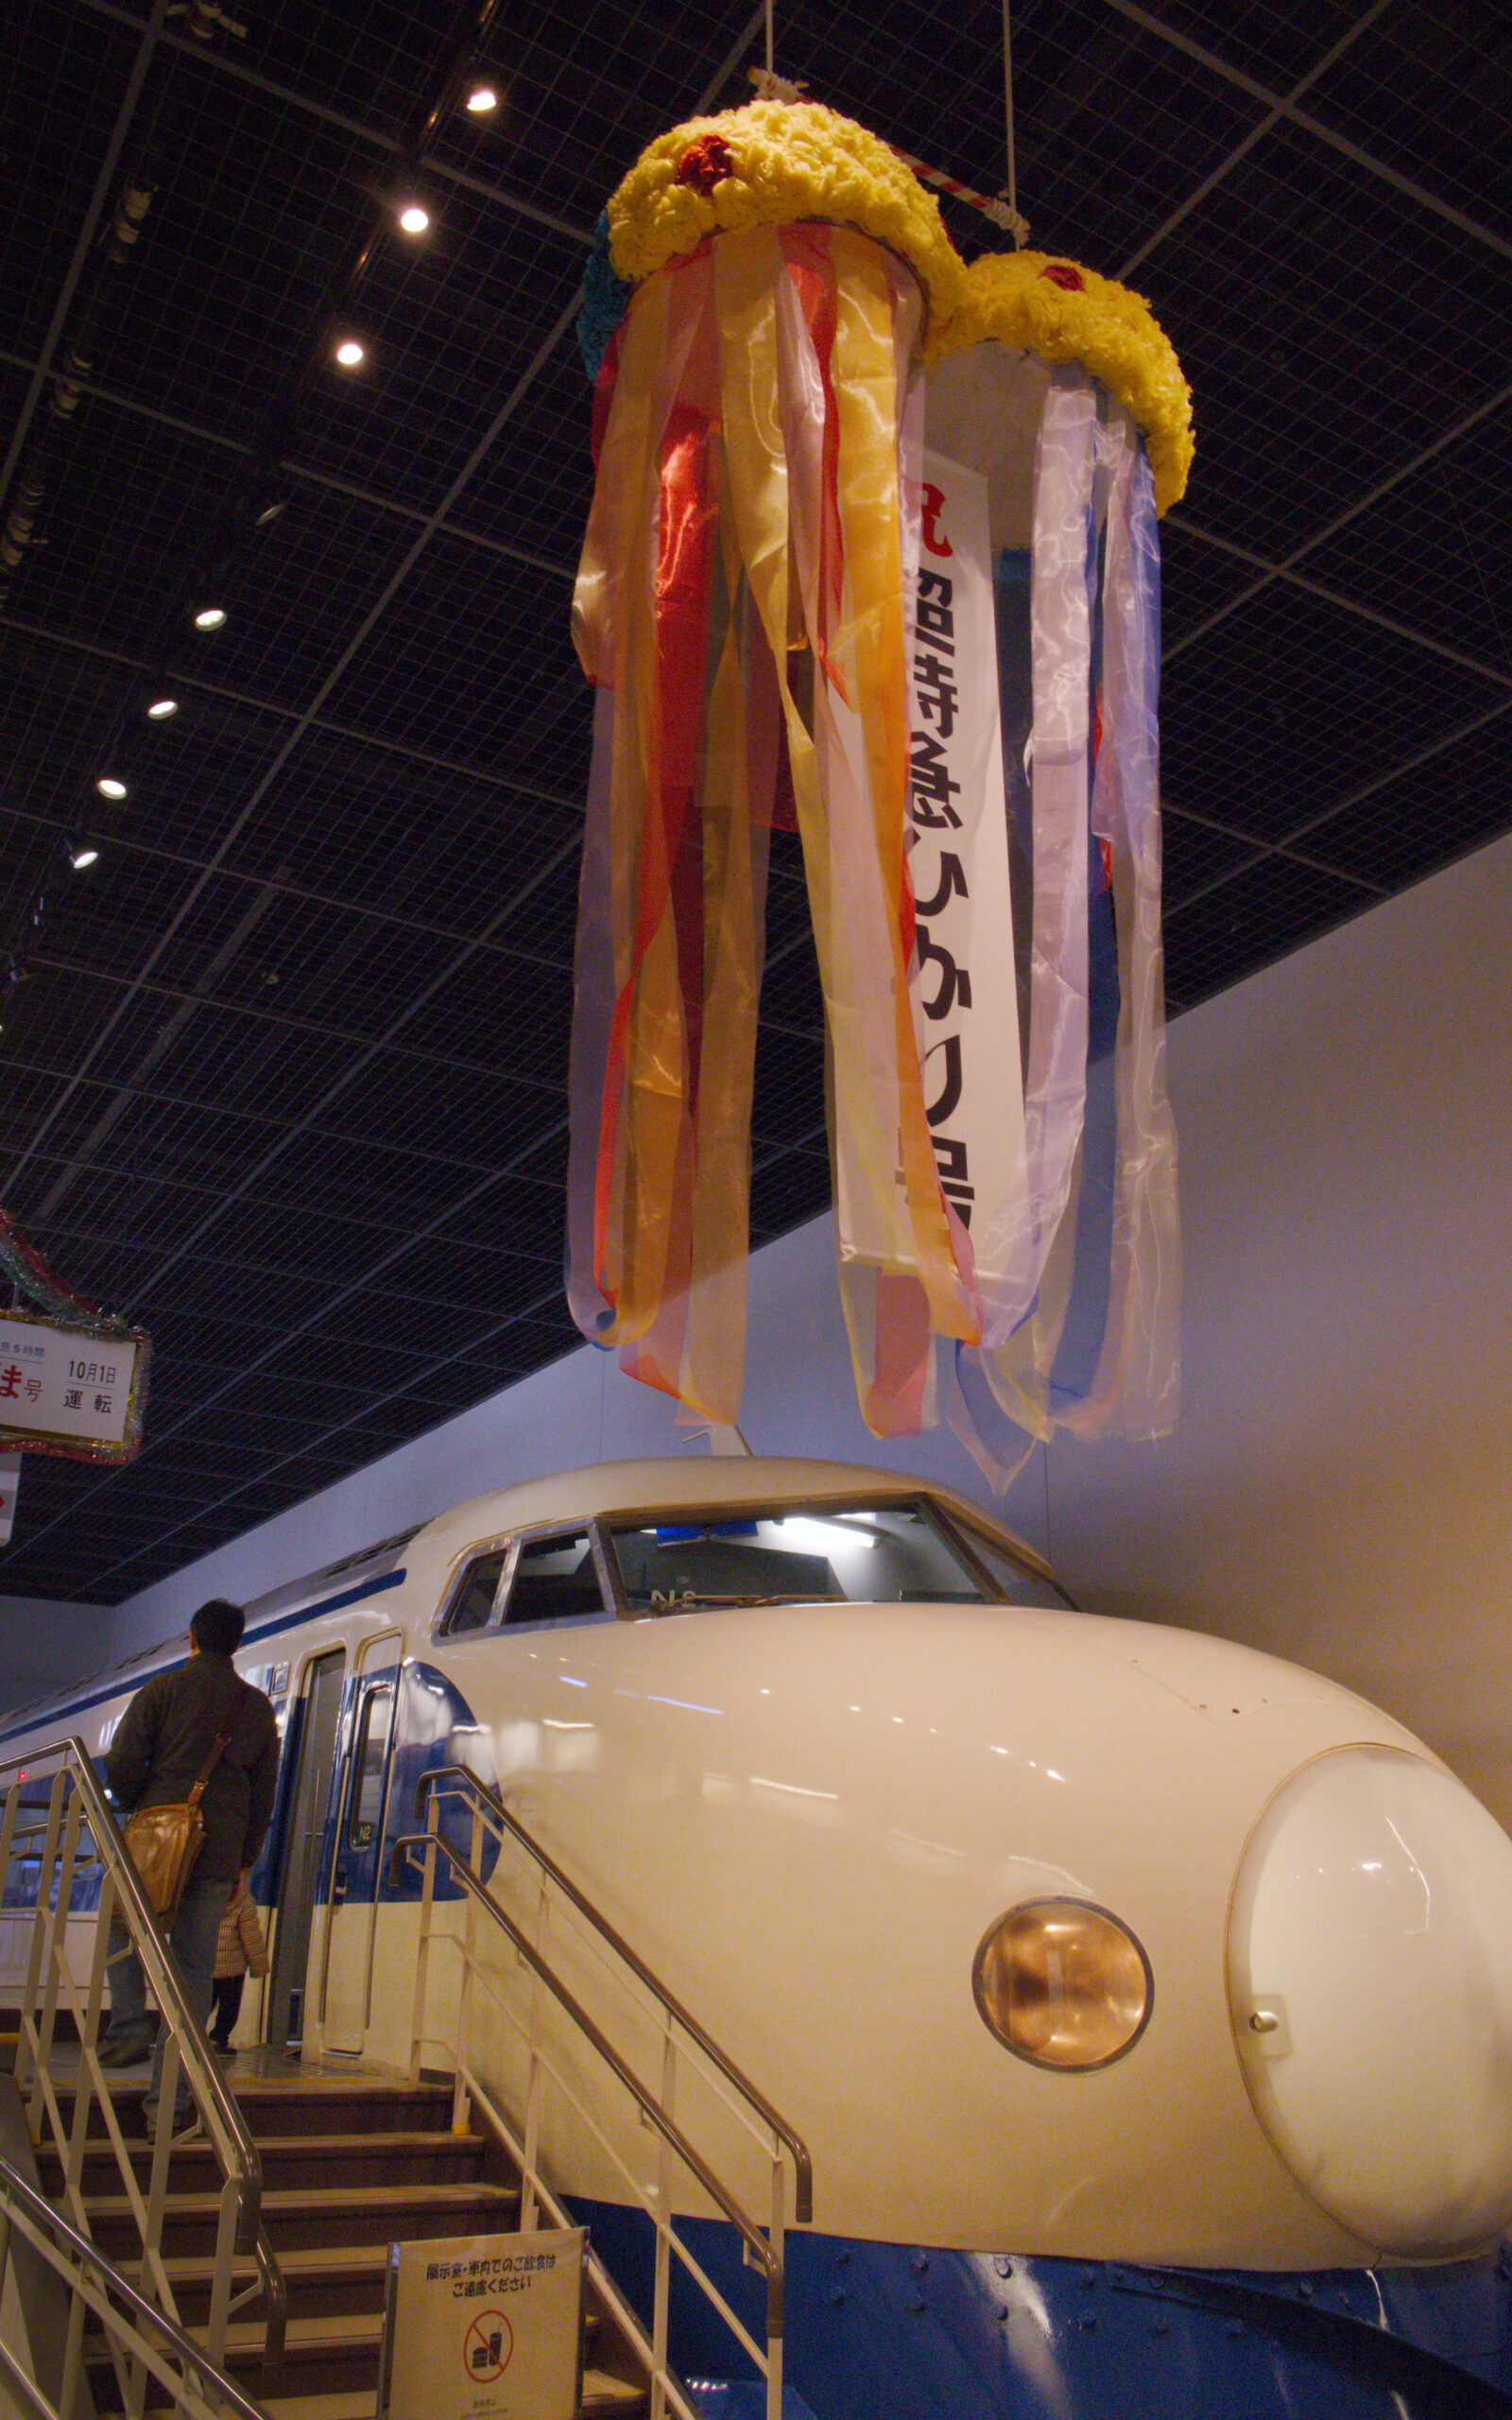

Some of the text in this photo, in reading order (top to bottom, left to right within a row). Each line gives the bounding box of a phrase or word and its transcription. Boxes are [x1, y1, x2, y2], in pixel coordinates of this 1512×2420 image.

[68, 1359, 116, 1384] 10月1日
[63, 1389, 112, 1414] 運転
[453, 2276, 531, 2297] ご遠慮ください
